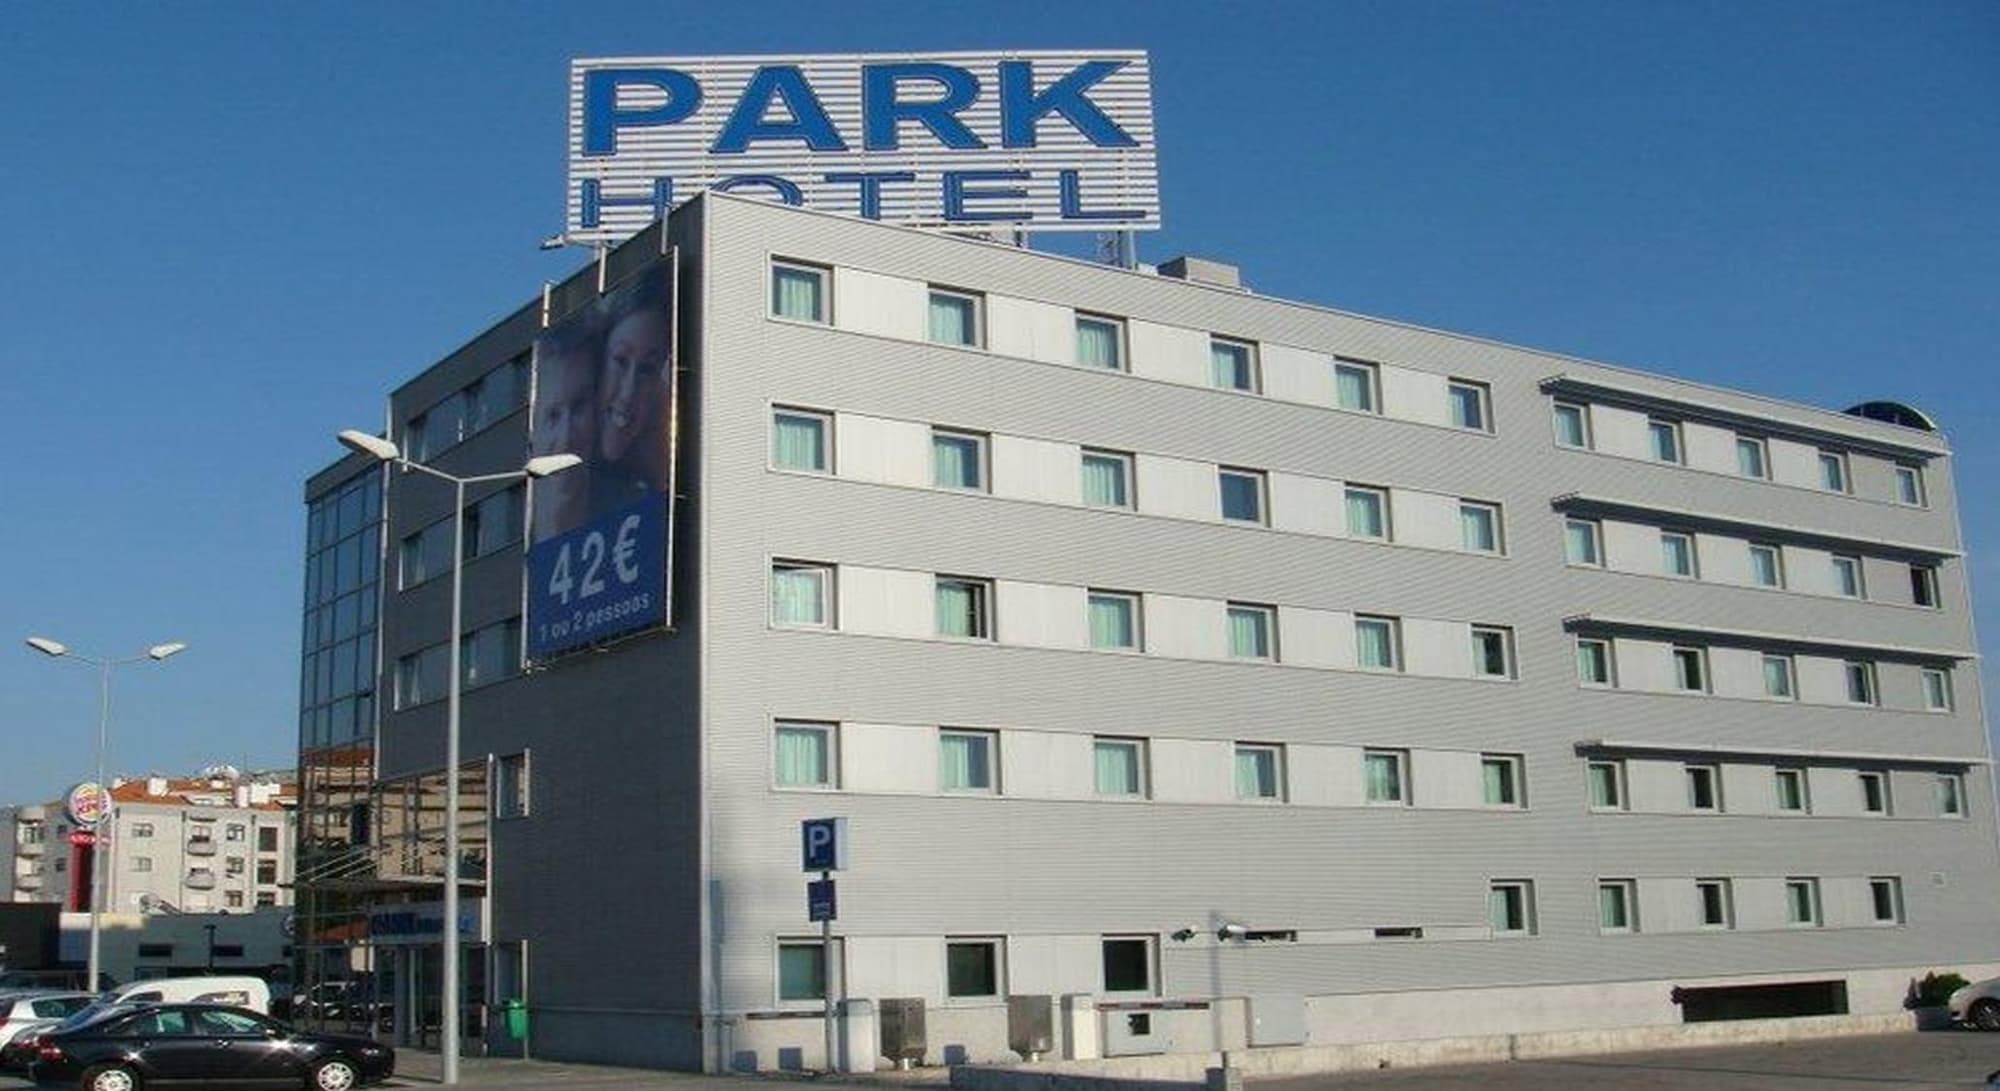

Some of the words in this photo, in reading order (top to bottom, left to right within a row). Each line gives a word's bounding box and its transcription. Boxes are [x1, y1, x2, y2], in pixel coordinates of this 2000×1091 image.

[582, 60, 1140, 157] PARK
[581, 170, 1147, 229] HOTEL
[549, 515, 641, 605] 42€
[573, 611, 583, 632] 2
[809, 825, 831, 858] P
